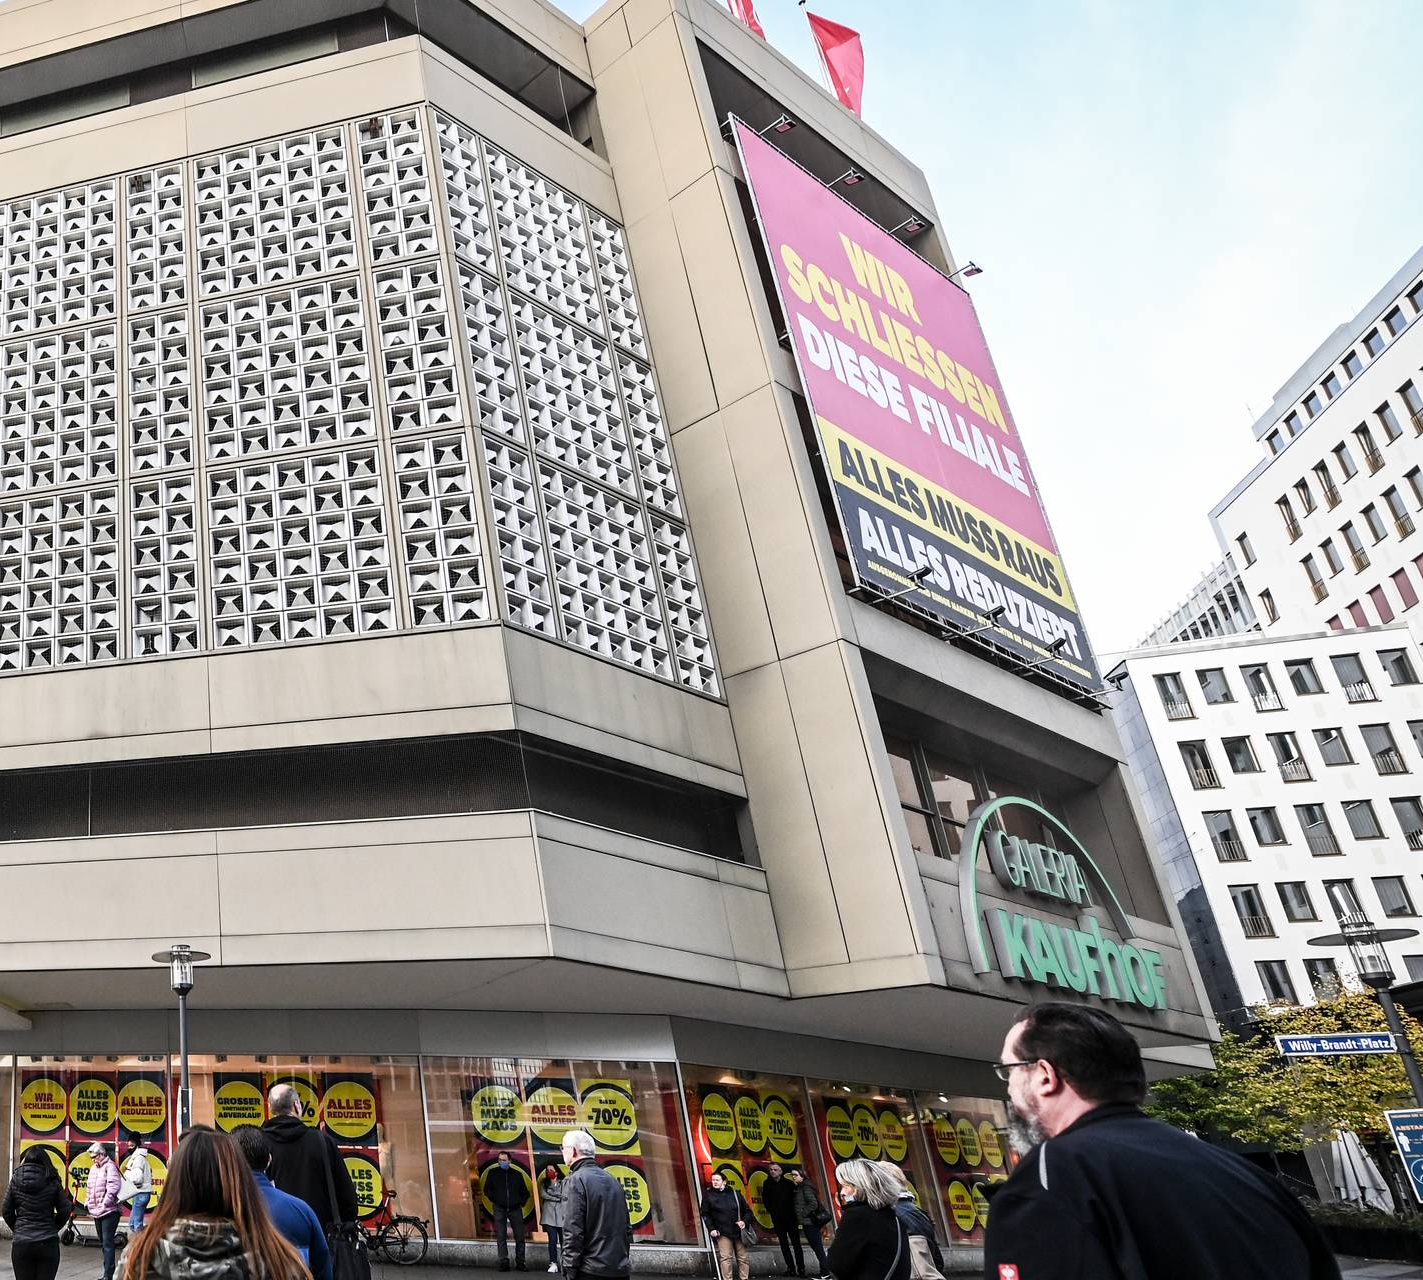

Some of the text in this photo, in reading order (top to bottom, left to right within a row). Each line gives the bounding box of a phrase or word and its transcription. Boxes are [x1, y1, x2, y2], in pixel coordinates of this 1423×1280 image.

[839, 232, 923, 326] WIR
[780, 244, 1009, 435] SCHLIESSEN
[797, 312, 1031, 498] DIESE FILIALE
[838, 438, 1063, 597] ALLES MUSS RAUS
[858, 507, 1083, 661] ALLES REDUZIERT
[985, 830, 1093, 908] GALERIA
[1288, 1038, 1390, 1052] Willy-Brandt-Platz
[34, 1093, 54, 1102] WIR
[77, 1089, 109, 1100] ALLES
[23, 1102, 64, 1110] SCHLIESSEN
[77, 1101, 109, 1111] MUSS
[121, 1096, 163, 1107] ALLES
[217, 1097, 262, 1106] GROSSER
[327, 1098, 372, 1111] ALLES
[480, 1097, 515, 1107] ALLES
[121, 1108, 163, 1116] REDUZIERT
[326, 1111, 373, 1119] REDUZIERT
[480, 1108, 516, 1119] MUSS
[531, 1104, 576, 1116] ALLES
[738, 1107, 759, 1117] ALLES
[76, 1111, 109, 1122] RAUS
[531, 1117, 576, 1125] REDUZIERT
[588, 1107, 632, 1126] -70%
[481, 1120, 518, 1131] RAUS
[740, 1118, 761, 1129] MUSS
[768, 1118, 793, 1136] -70%
[742, 1130, 762, 1141] RAUS
[857, 1126, 878, 1141] -70%
[351, 1169, 372, 1179] LES
